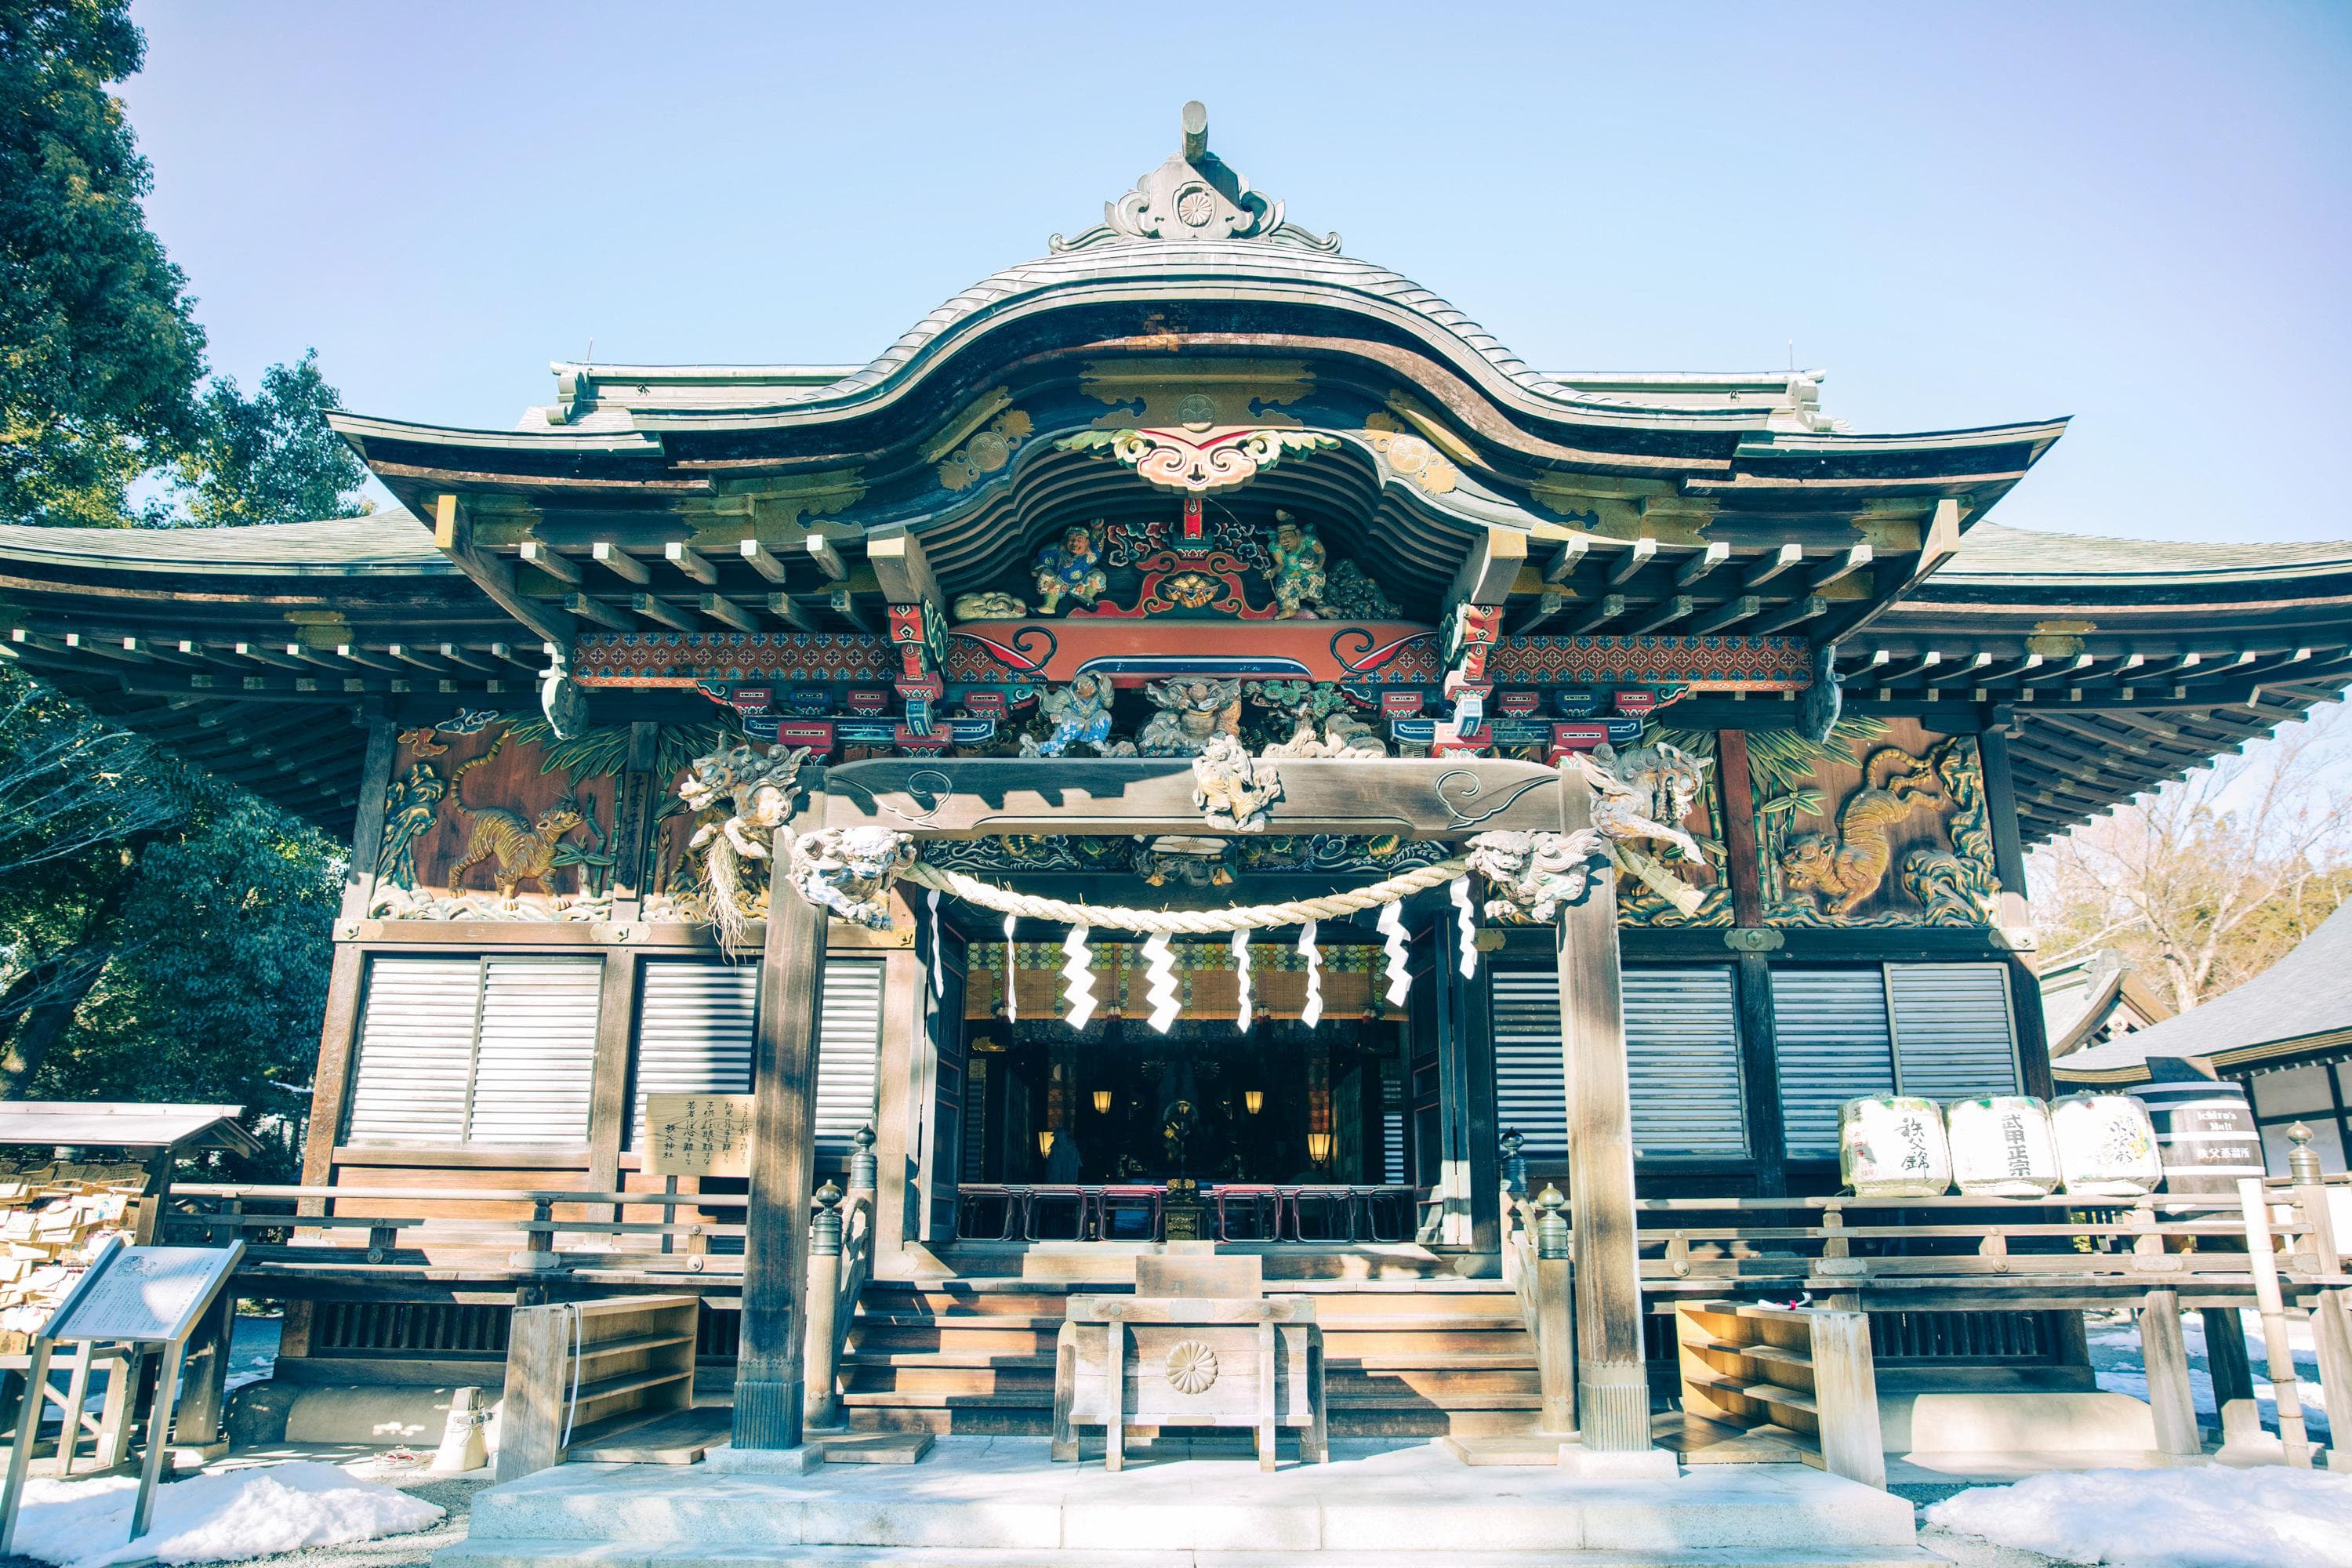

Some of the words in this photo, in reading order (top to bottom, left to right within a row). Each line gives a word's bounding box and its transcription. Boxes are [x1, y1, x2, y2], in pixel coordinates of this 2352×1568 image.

[662, 1123, 677, 1159] 秩父神社
[2209, 1122, 2233, 1131] Malt
[2002, 1114, 2031, 1177] 武甲正宗
